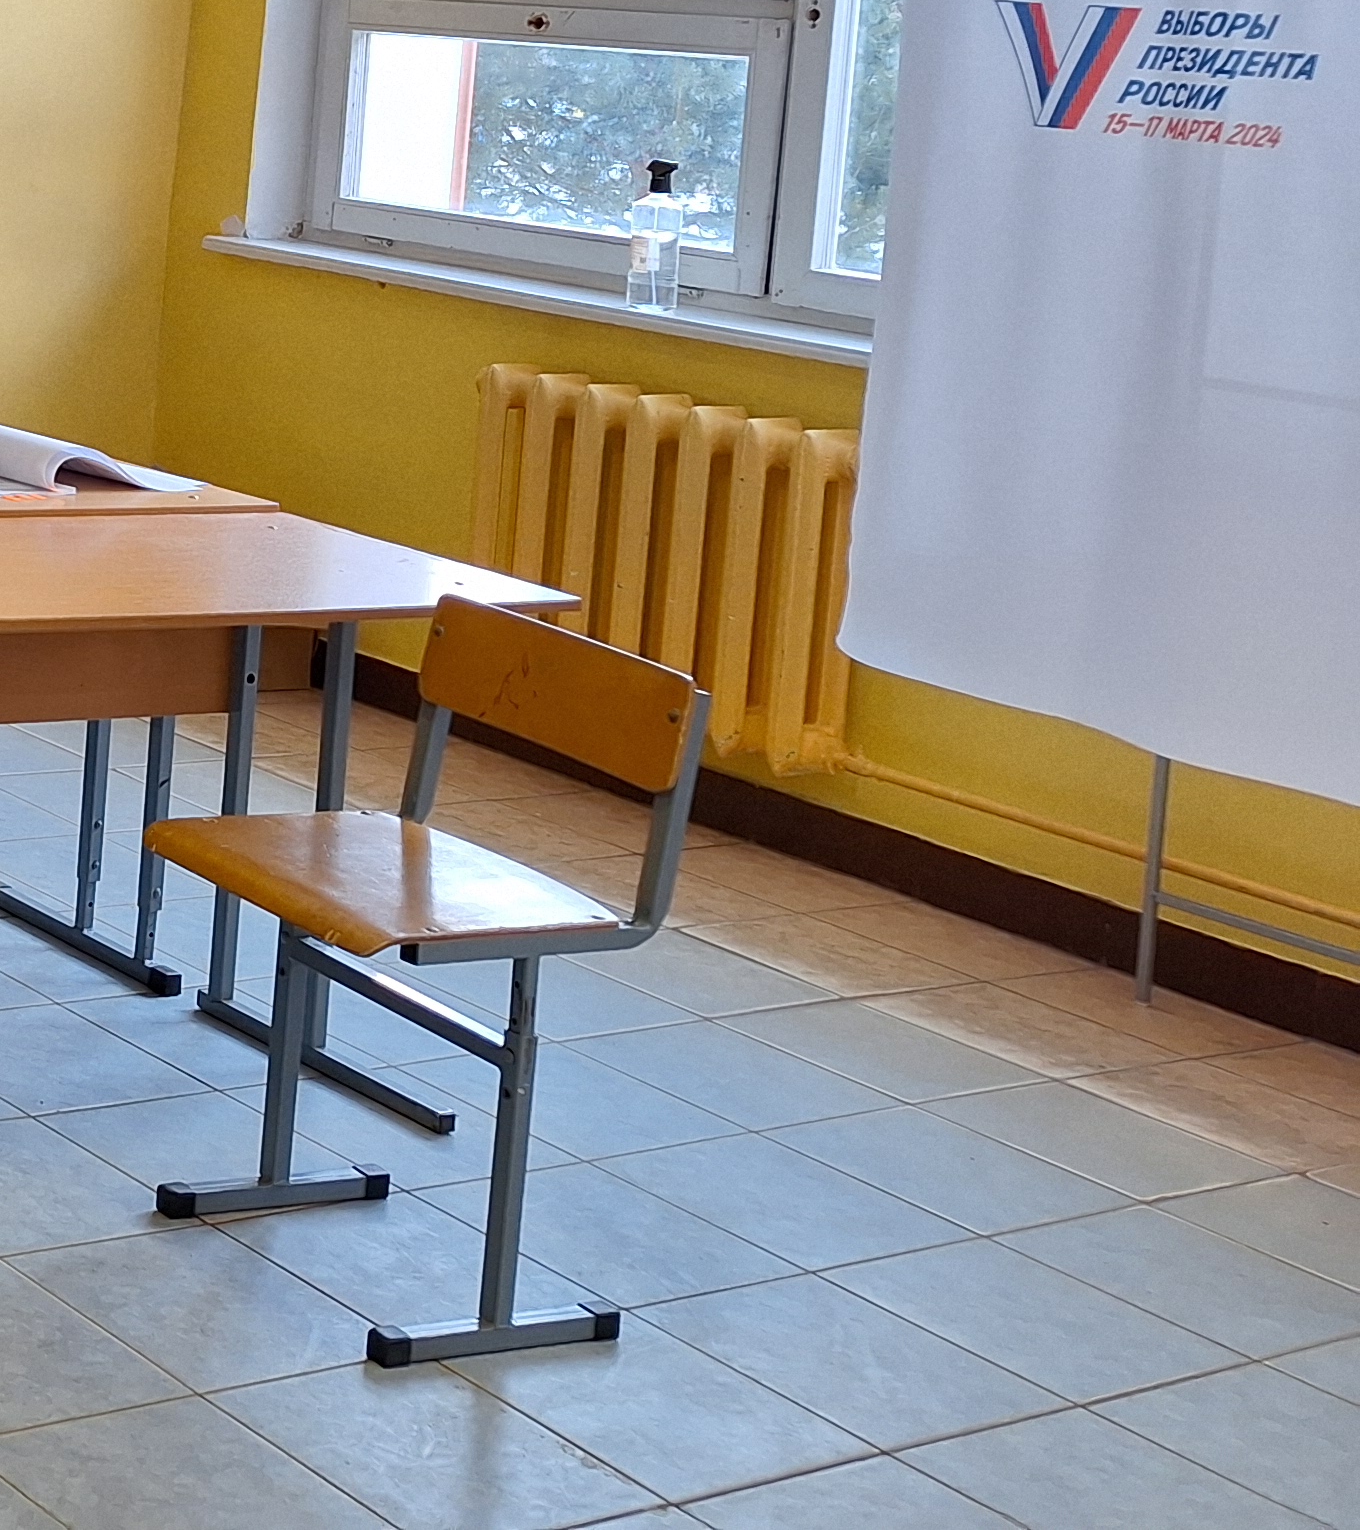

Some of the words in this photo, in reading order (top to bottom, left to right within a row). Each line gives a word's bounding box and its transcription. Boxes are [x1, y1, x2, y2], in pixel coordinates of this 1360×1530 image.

[1154, 9, 1281, 40] ВЫБОРЫ
[1136, 44, 1320, 81] ПРЕЗИДЕНТА
[1116, 79, 1229, 111] РОССИИ
[1162, 116, 1225, 144] МАРТА
[1225, 123, 1284, 149] 2024
